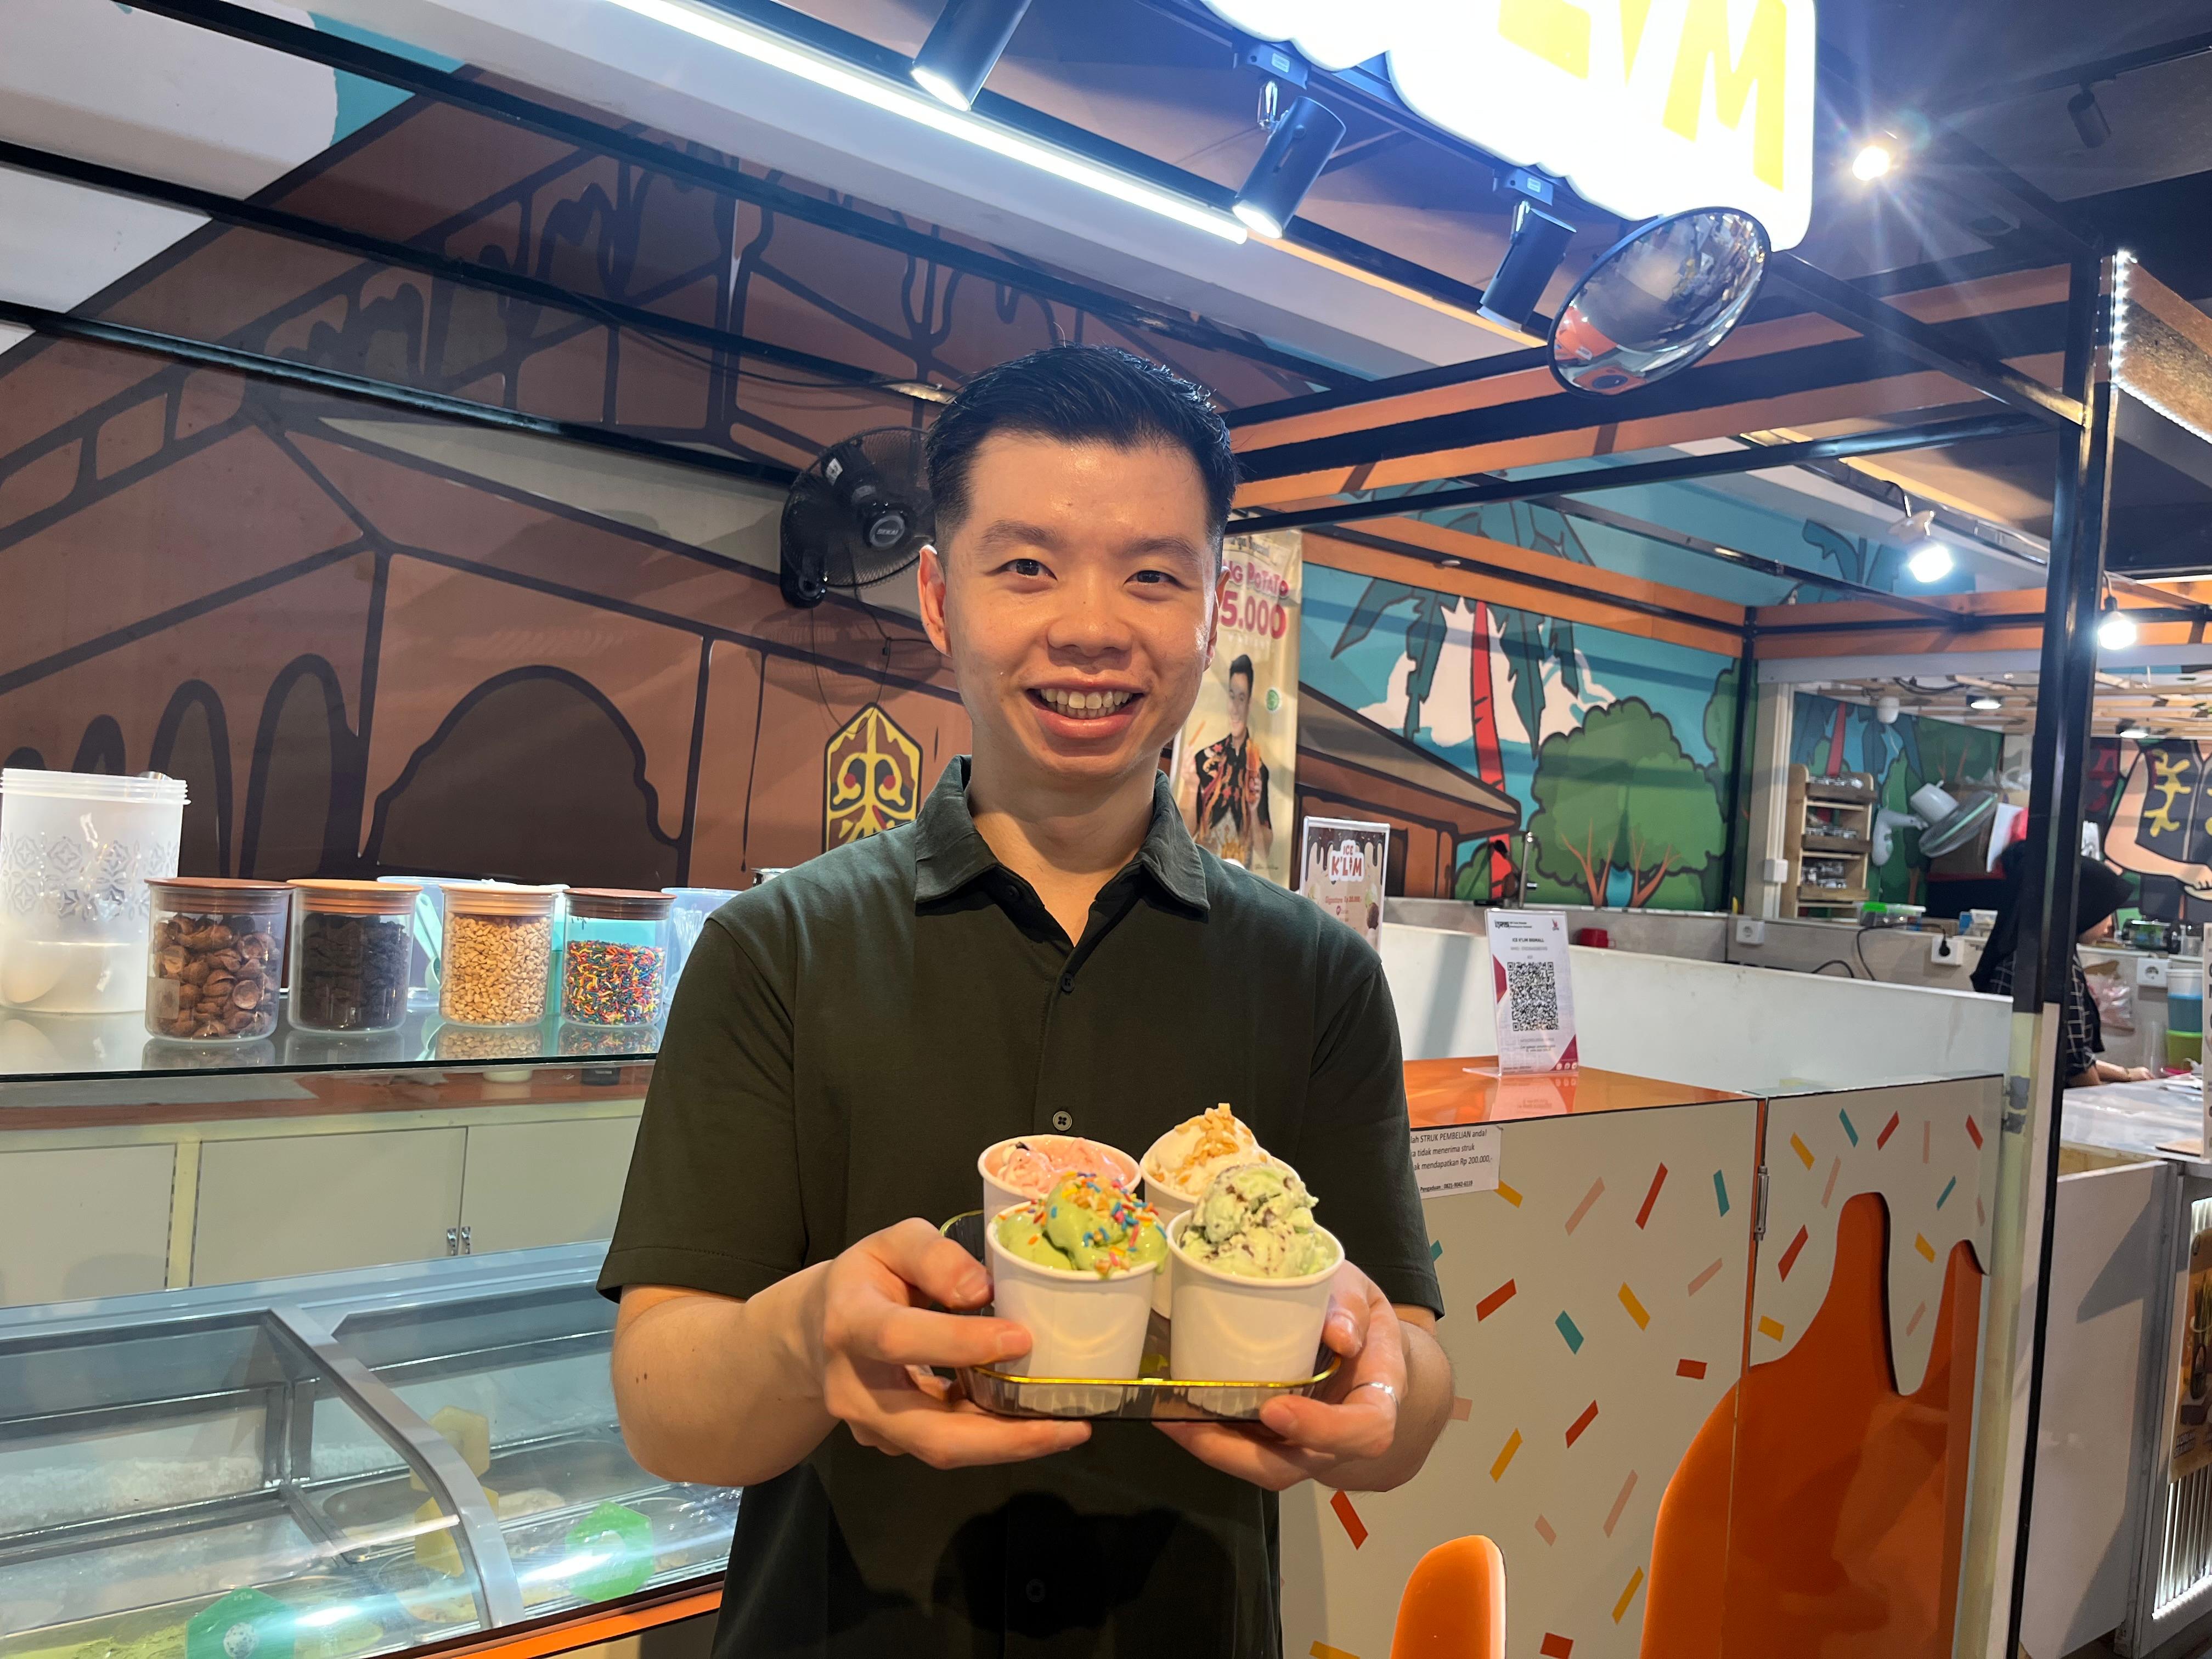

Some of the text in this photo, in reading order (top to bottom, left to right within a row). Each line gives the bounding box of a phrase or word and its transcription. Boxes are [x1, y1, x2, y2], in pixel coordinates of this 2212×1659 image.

[1221, 590, 1286, 640] 5.000
[1343, 845, 1354, 855] ICE
[1420, 1134, 1438, 1143] STRUK
[1440, 1131, 1471, 1141] PEMBELIAN
[1472, 1128, 1487, 1138] anda!
[1418, 1148, 1431, 1156] tidak
[1432, 1146, 1460, 1154] menerima
[1462, 1143, 1475, 1152] struk
[1421, 1159, 1459, 1169] mendapatkan
[1460, 1158, 1468, 1166] Rp
